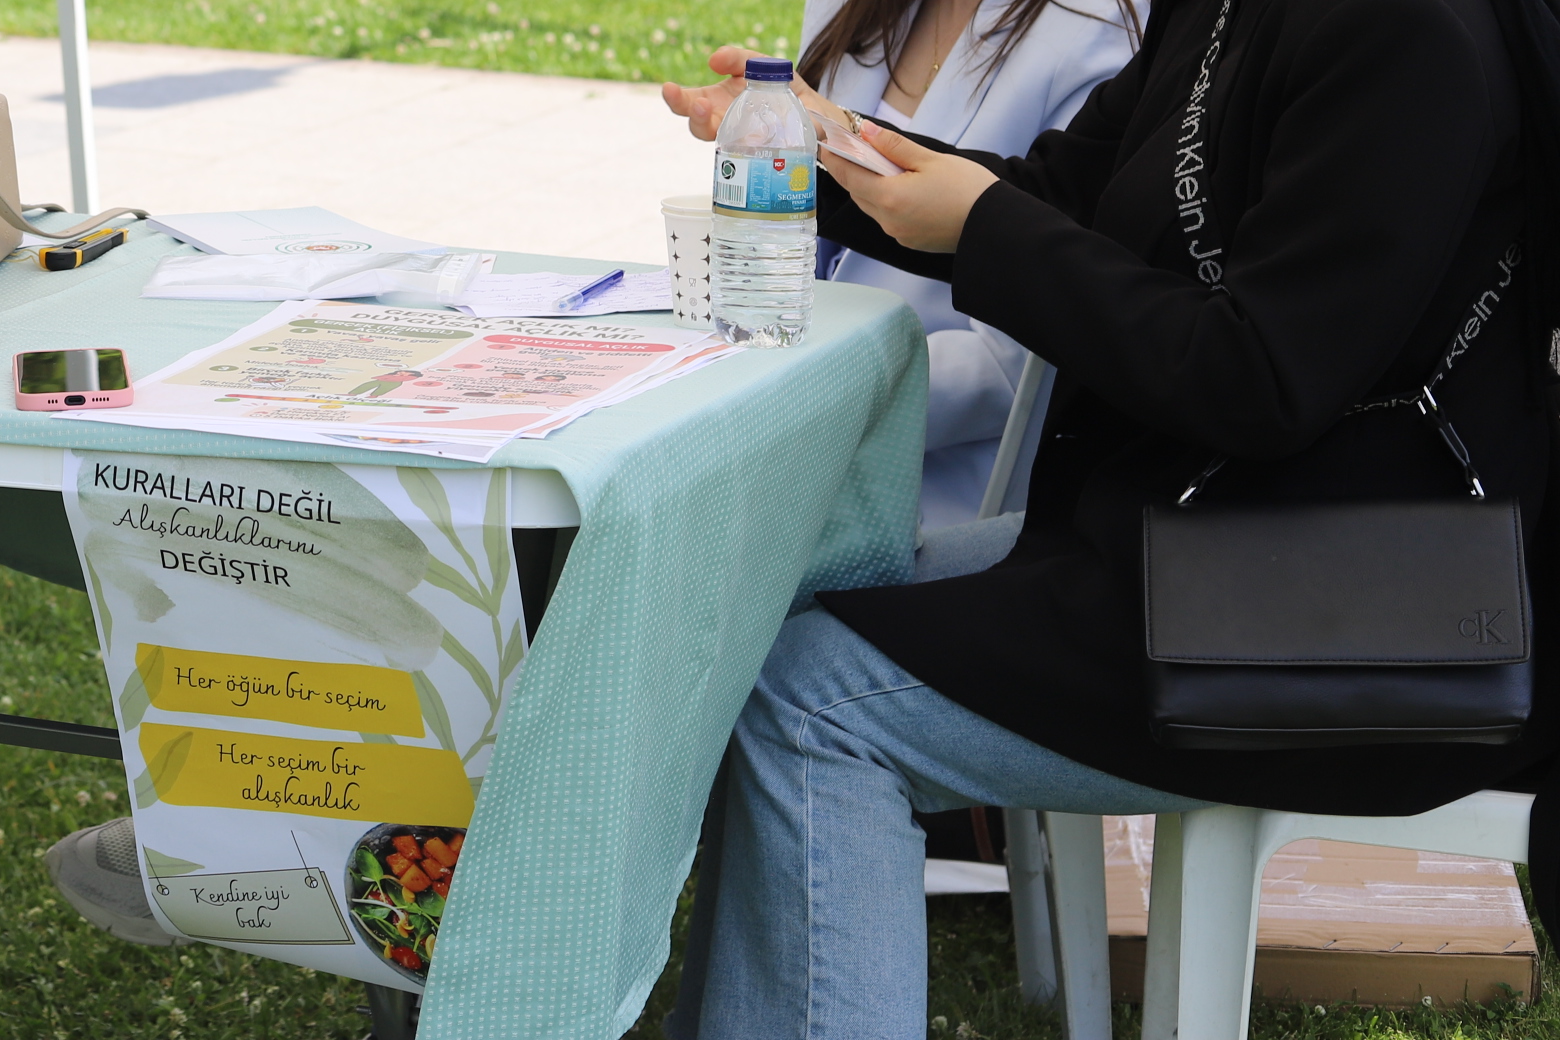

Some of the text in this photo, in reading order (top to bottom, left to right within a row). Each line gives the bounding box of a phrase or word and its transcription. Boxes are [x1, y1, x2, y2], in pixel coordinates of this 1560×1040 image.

[1174, 140, 1207, 233] Klein
[314, 319, 373, 329] GERÇEK
[350, 313, 496, 330] DUYGUSAL
[503, 326, 585, 338] AÇLIK
[496, 319, 582, 329] AÇLIK
[1446, 290, 1500, 369] Klein
[509, 337, 595, 348] DUYGUSAL
[93, 462, 341, 525] KURALLARI DEĞİL
[111, 503, 323, 557] Alışkanlıklarını
[159, 548, 293, 589] DEĞİŞTİR
[173, 666, 386, 713] Her öğün bir seçim
[216, 743, 365, 778] Her seçim bir
[241, 774, 360, 812] alışkanlık
[190, 880, 290, 914] Kendine iyi
[235, 906, 271, 930] bak
